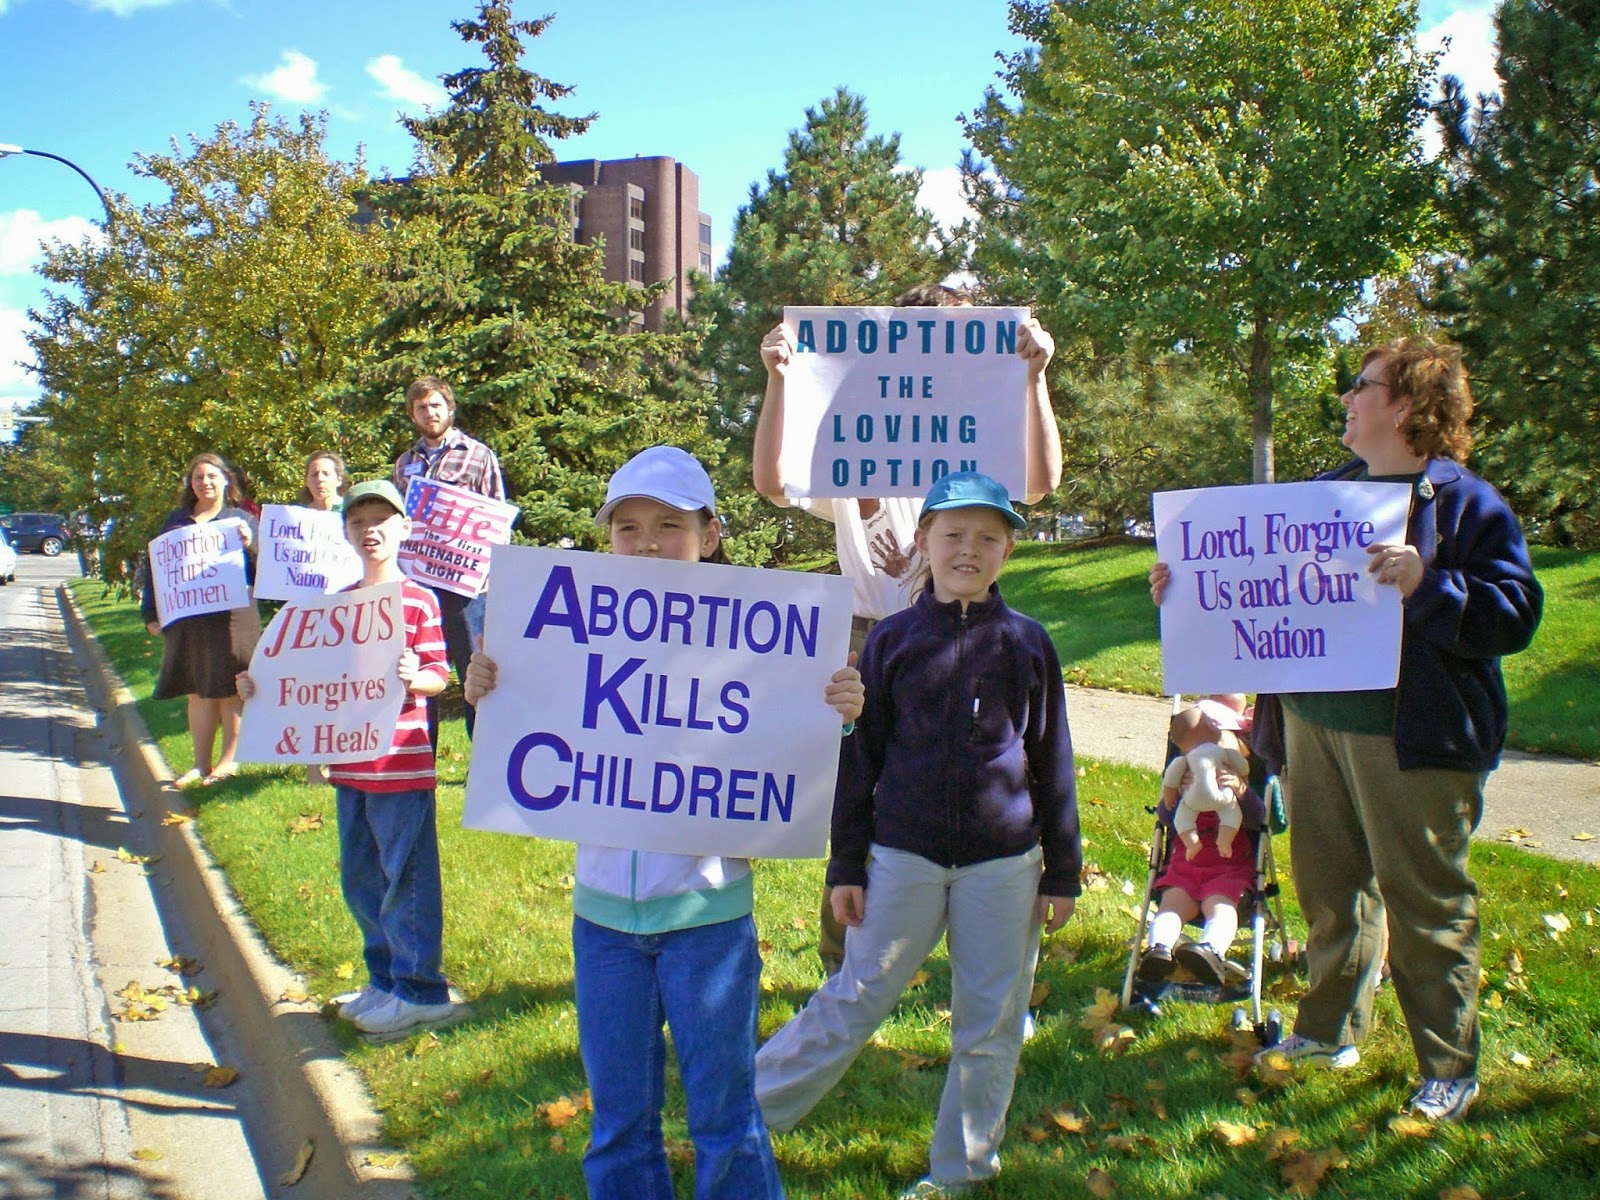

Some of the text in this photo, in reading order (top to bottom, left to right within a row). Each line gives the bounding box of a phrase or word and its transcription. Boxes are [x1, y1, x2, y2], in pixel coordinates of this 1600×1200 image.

[796, 319, 1017, 355] ADOPTION
[878, 375, 933, 398] THE
[833, 414, 976, 444] LOVING
[269, 518, 305, 543] Lord,
[413, 485, 491, 545] Life
[156, 530, 228, 566] Abortion
[274, 542, 289, 562] Us
[292, 545, 317, 563] and
[424, 529, 482, 555] the first
[1180, 509, 1374, 566] Lord, Forgive
[164, 557, 218, 587] Hurts
[285, 566, 329, 590] Nation
[425, 561, 464, 582] RIGHT
[1194, 562, 1359, 611] Us and Our
[163, 583, 228, 613] Women
[523, 565, 820, 658] ABORTION
[264, 596, 393, 658] JESUS
[1232, 616, 1327, 661] Nation
[277, 673, 385, 711] Forgives
[581, 653, 750, 736] KILLS
[275, 722, 379, 755] & Heals
[506, 731, 796, 823] CHILDREN
